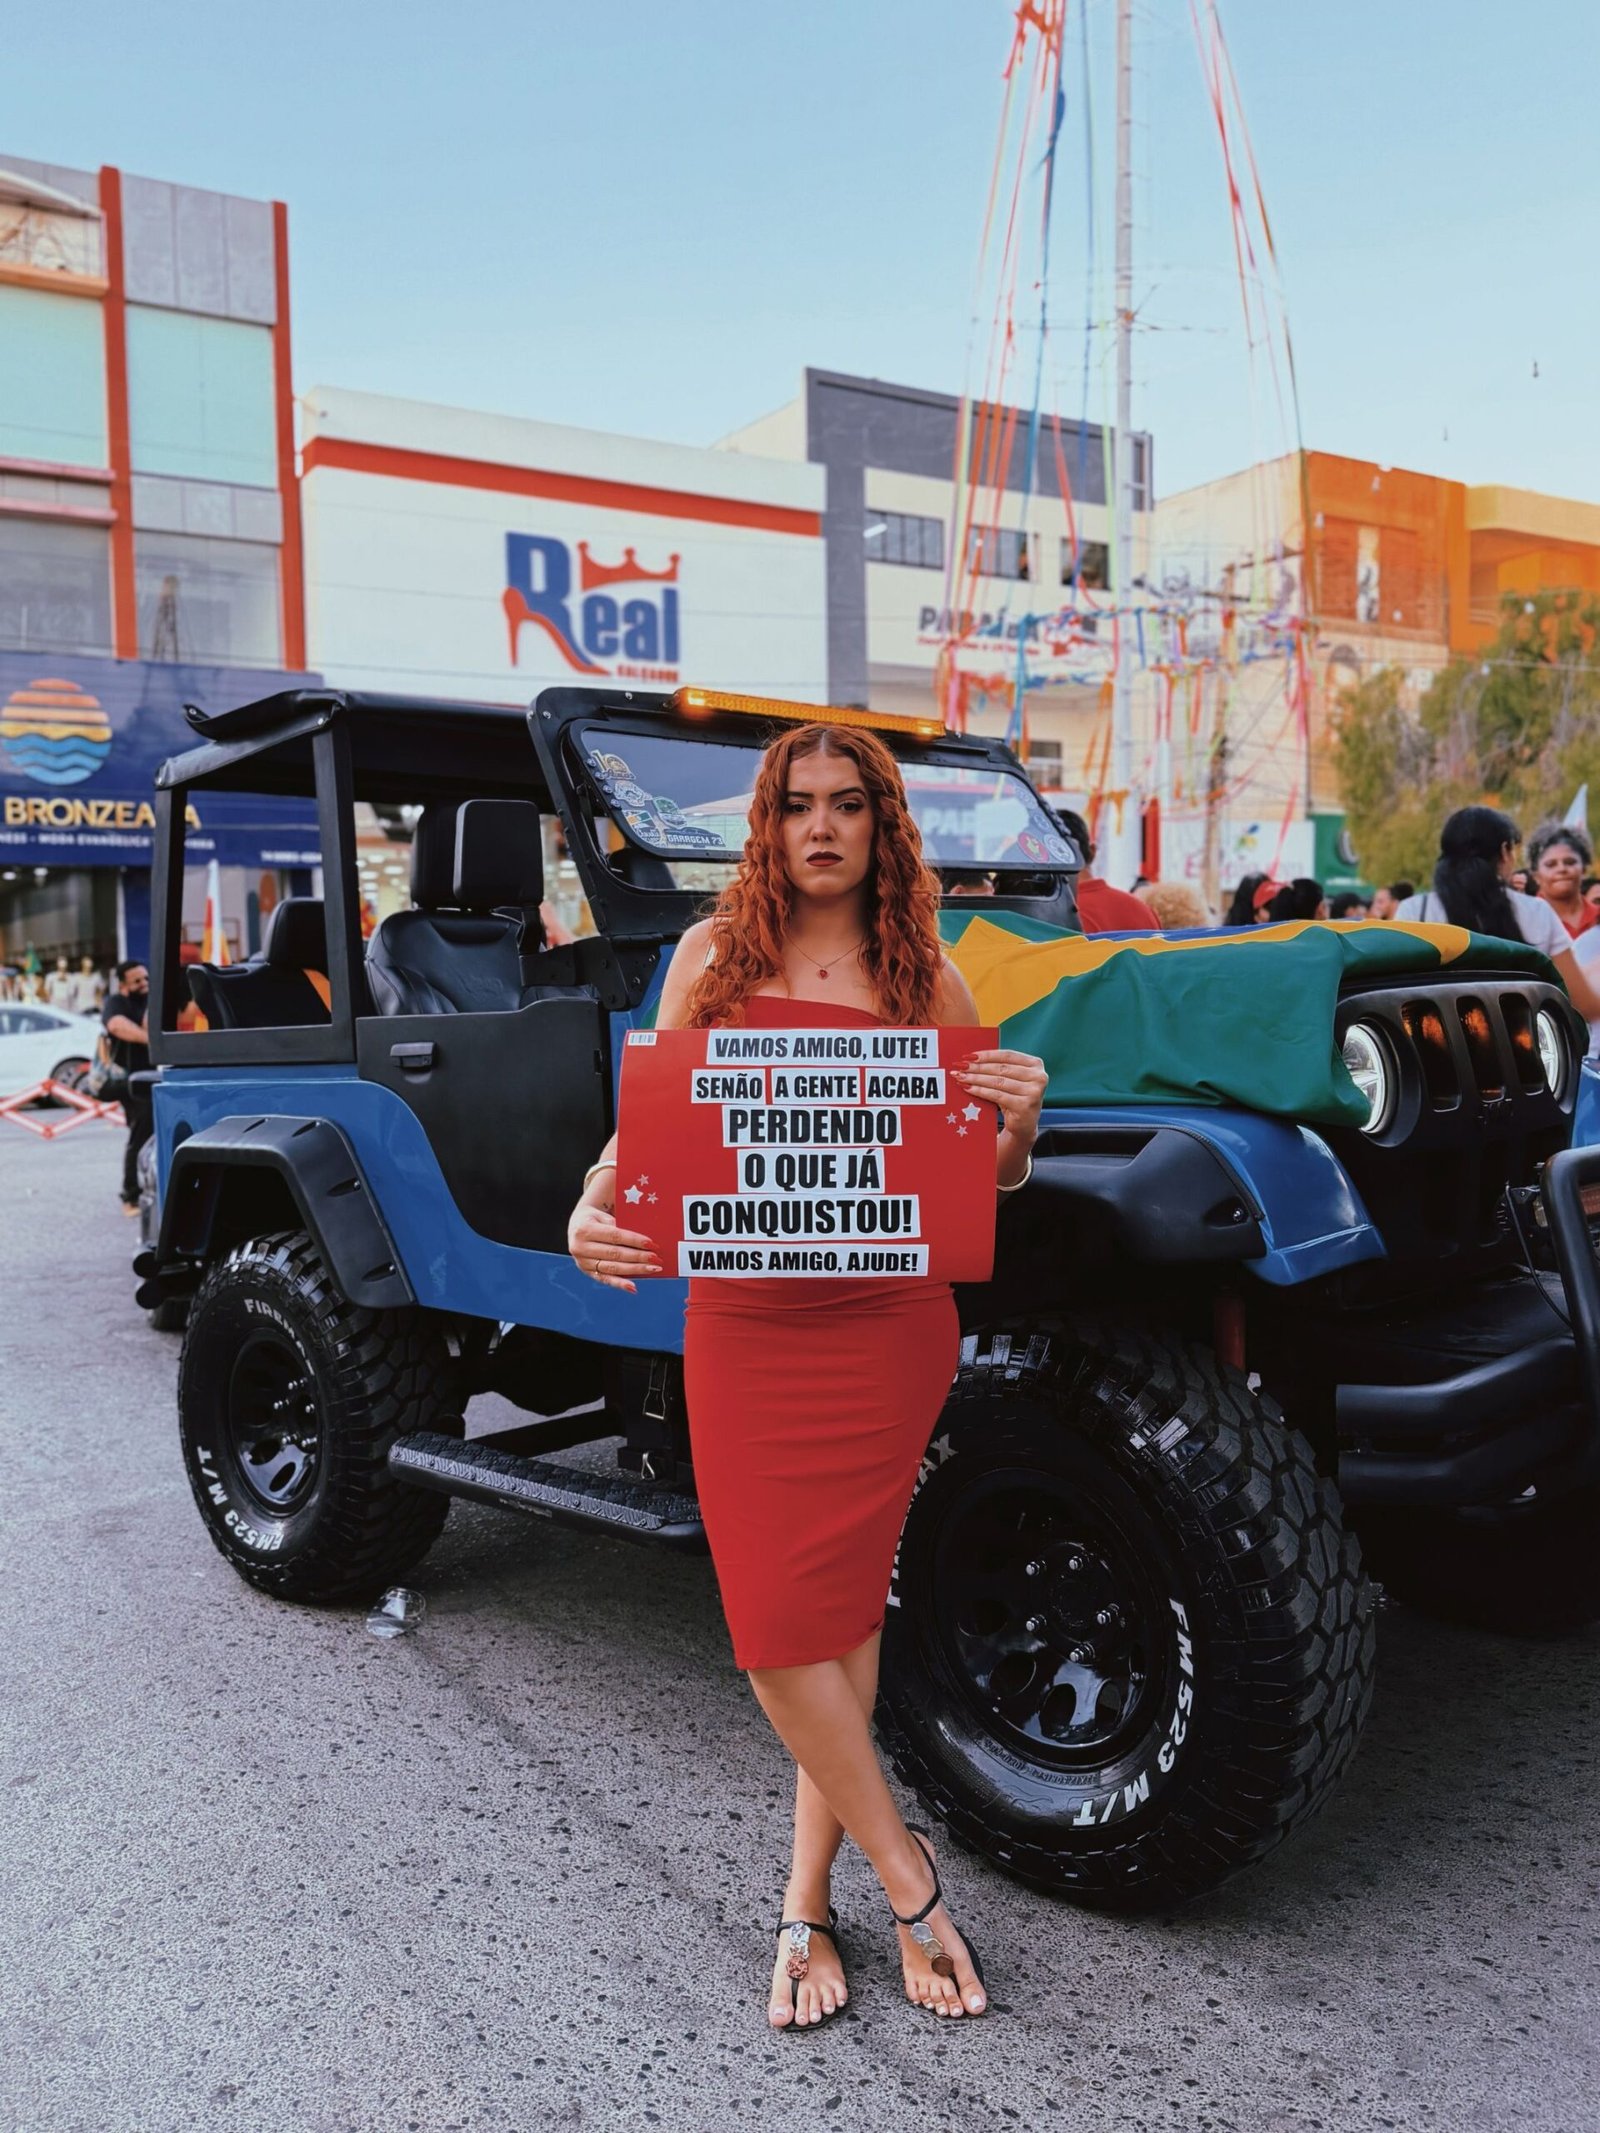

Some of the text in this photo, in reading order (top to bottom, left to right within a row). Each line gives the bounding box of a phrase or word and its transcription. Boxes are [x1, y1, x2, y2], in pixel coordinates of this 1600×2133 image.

[503, 530, 680, 669] Real
[5, 797, 201, 830] BRONZEAA
[715, 1036, 928, 1061] VAMOS AMIGO, LUTE!
[696, 1072, 939, 1100] SENÃO A GENTE ACABA
[729, 1109, 897, 1144] PERDENDO
[744, 1148, 880, 1192] O QUE JÁ
[688, 1199, 912, 1238] CONQUISTOU!
[688, 1250, 918, 1274] VAMOS AMIGO, AJUDE!
[224, 1509, 285, 1551] FM523
[1072, 1598, 1195, 1827] FM523 M/T
